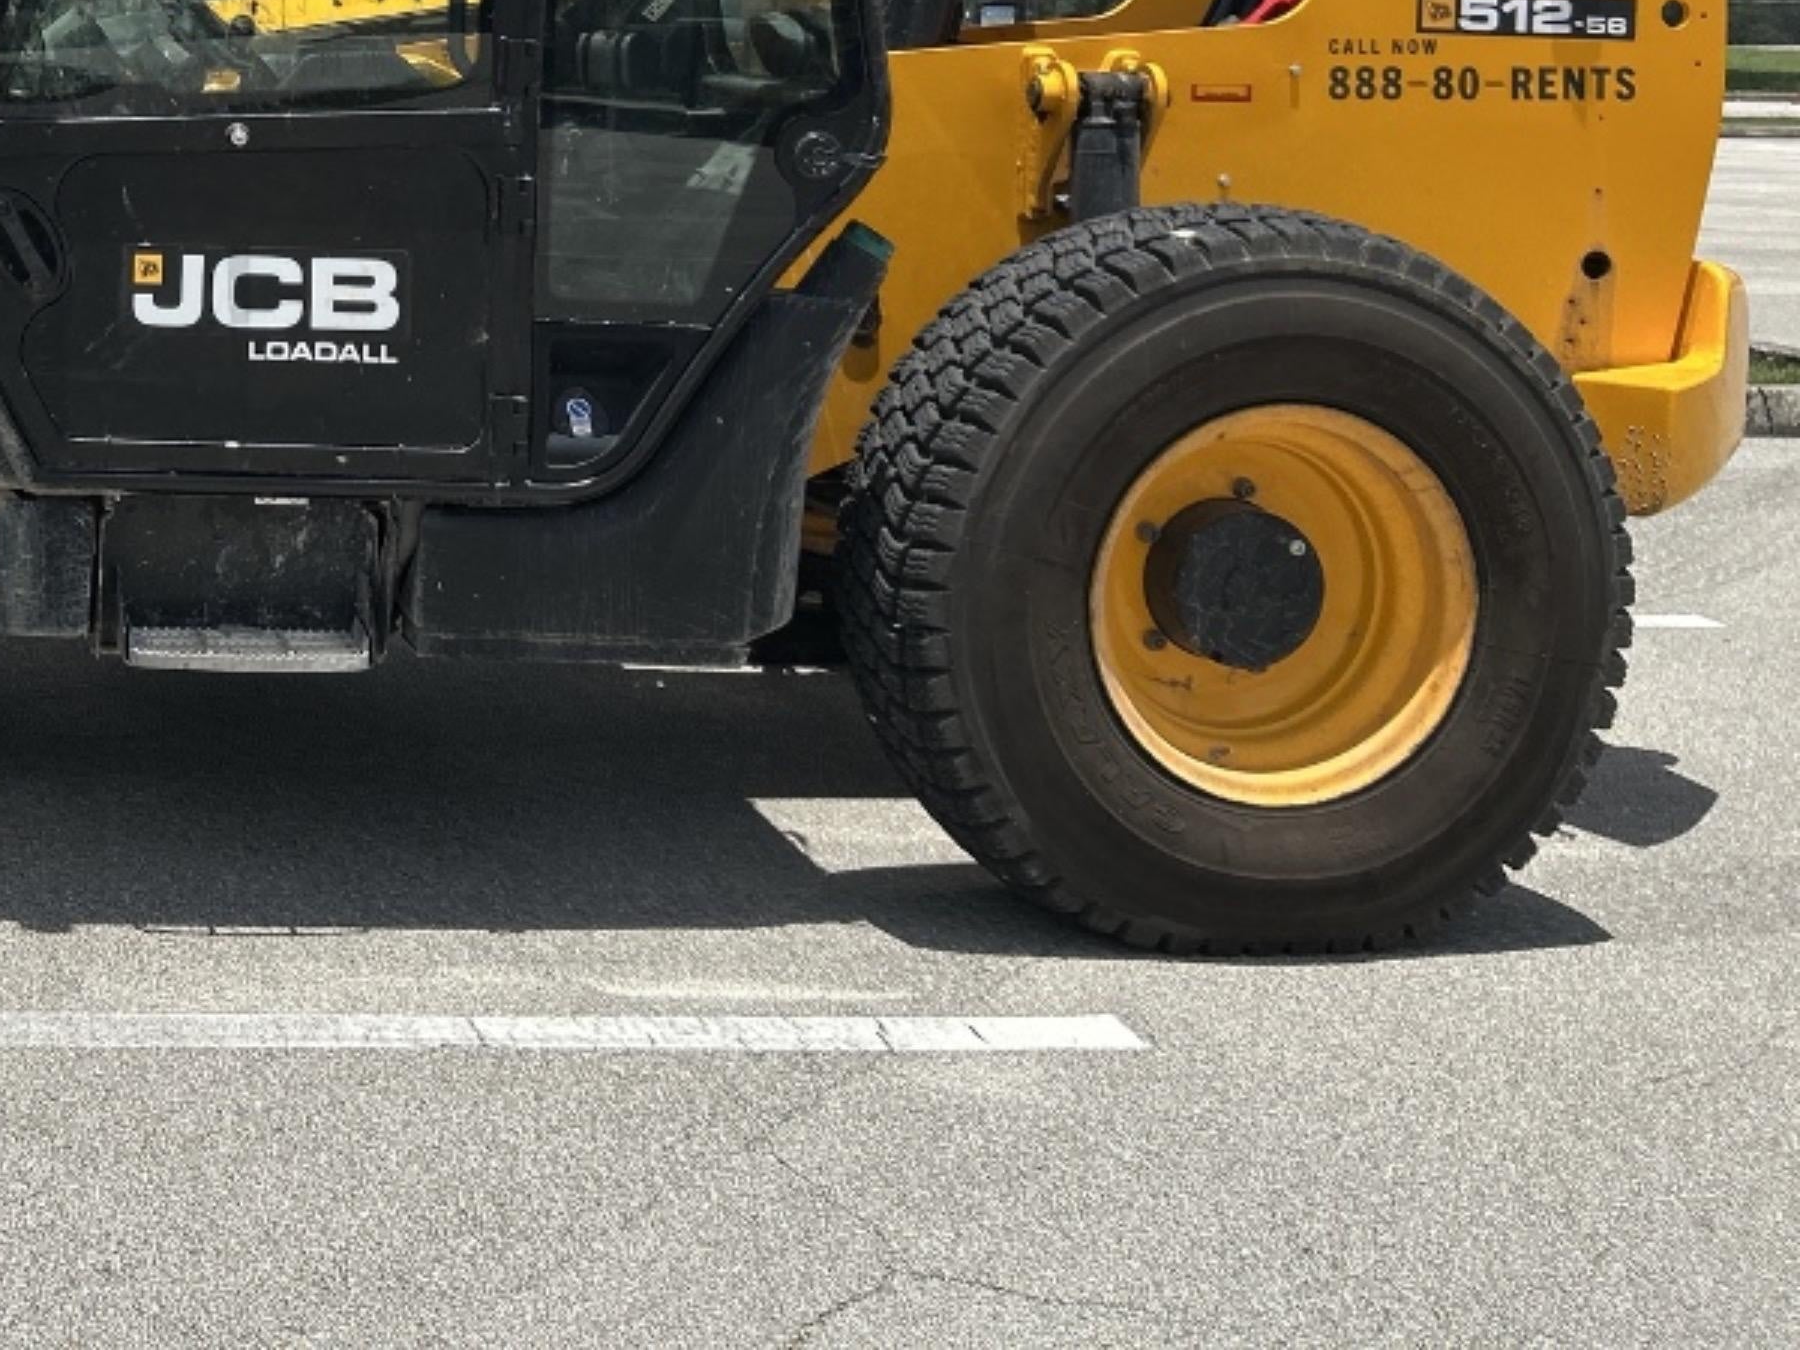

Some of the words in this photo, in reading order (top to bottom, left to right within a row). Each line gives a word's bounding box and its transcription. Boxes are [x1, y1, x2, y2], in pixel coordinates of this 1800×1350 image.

[1327, 38, 1382, 57] CALL
[1391, 38, 1439, 57] NOW
[1327, 66, 1637, 103] 888-80-RENTS
[132, 253, 400, 332] JCB
[248, 341, 399, 365] LOADALL
